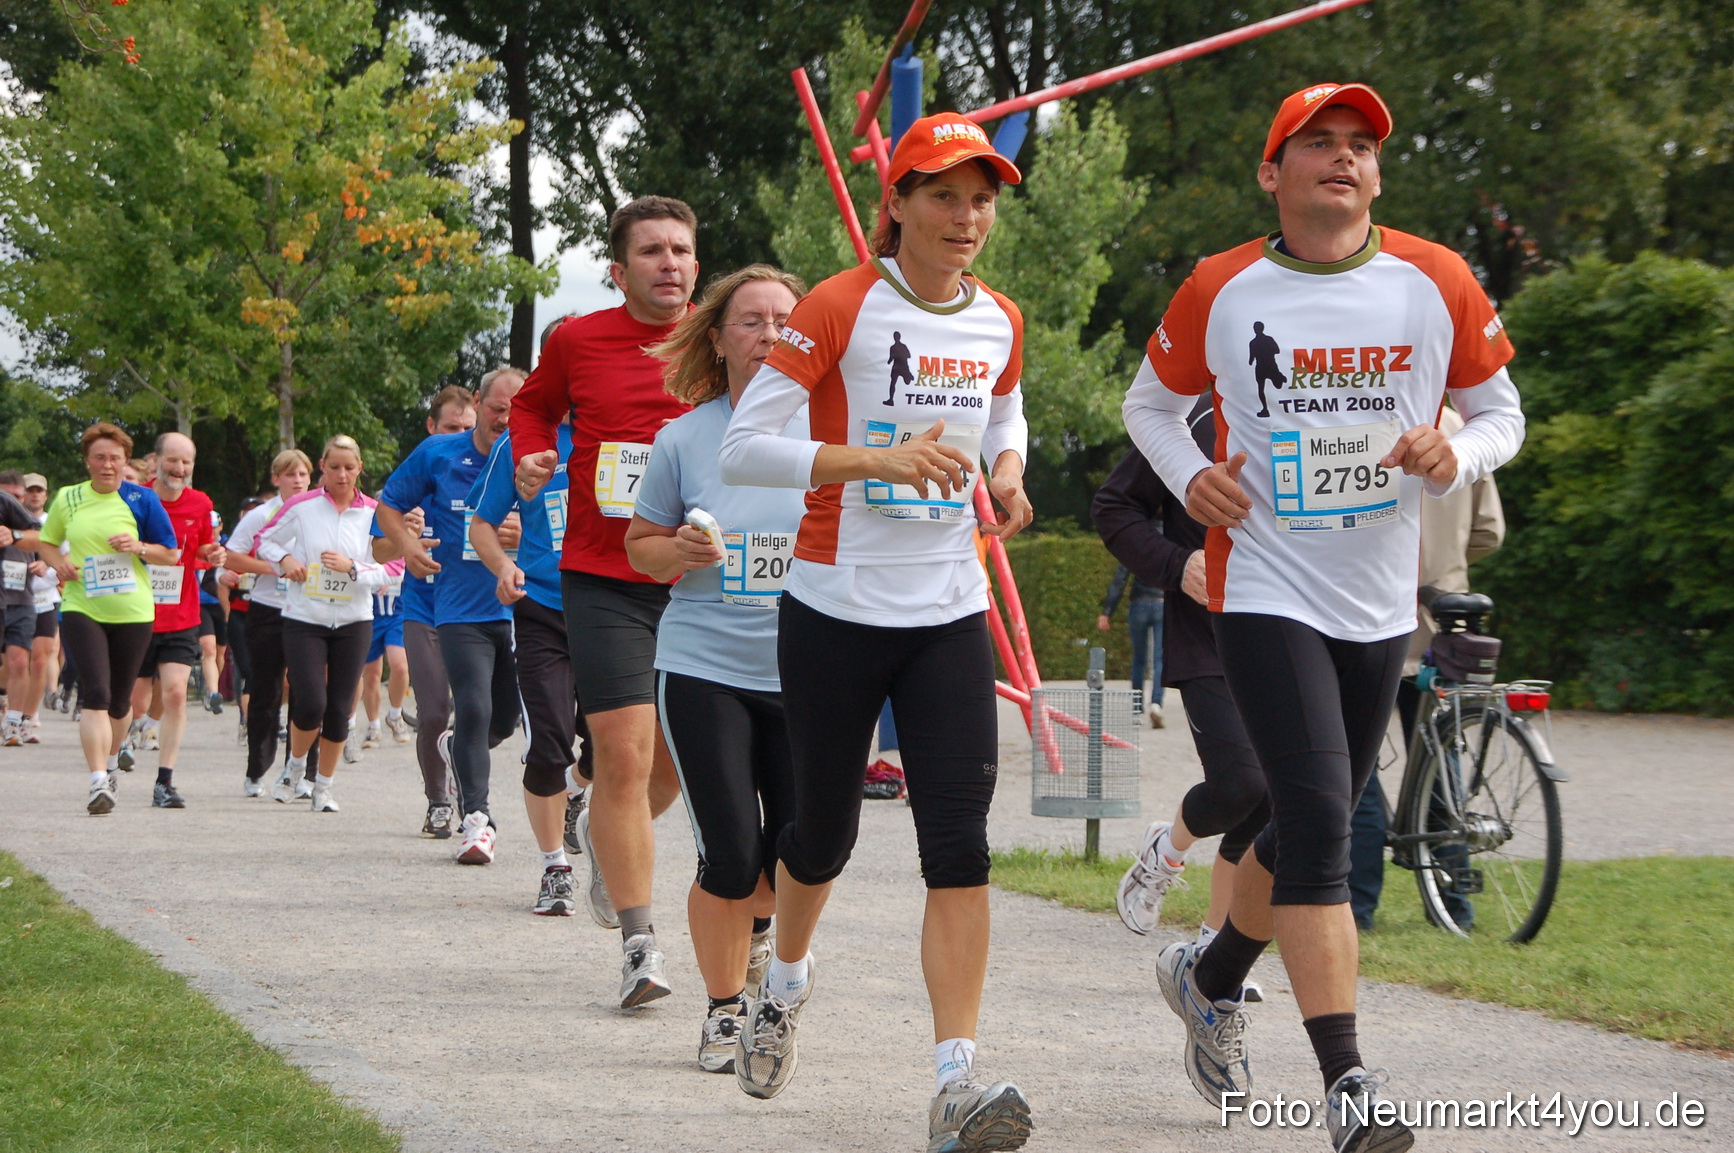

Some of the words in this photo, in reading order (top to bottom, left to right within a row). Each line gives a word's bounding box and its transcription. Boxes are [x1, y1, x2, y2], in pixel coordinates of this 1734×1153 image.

[933, 123, 990, 146] MER
[779, 326, 816, 355] ERZ
[1157, 320, 1173, 354] RZ
[919, 355, 990, 380] MERZ
[1293, 345, 1412, 374] MERZ
[914, 369, 978, 389] Reisen
[1288, 365, 1387, 389] Reisen
[904, 393, 947, 406] TEAM
[951, 395, 984, 409] 2008
[1278, 397, 1339, 414] TEAM
[1345, 396, 1397, 412] 2008
[1310, 433, 1369, 457] Michael
[627, 473, 643, 494] 7
[1282, 469, 1291, 483] C
[1314, 462, 1389, 495] 2795
[1357, 506, 1398, 522] PFLEIDERER
[752, 533, 788, 551] Helga
[728, 555, 734, 566] C
[100, 567, 130, 581] 2832
[152, 569, 171, 577] Walter
[321, 568, 332, 576] Iris
[152, 579, 178, 590] 2388
[324, 579, 347, 592] 327
